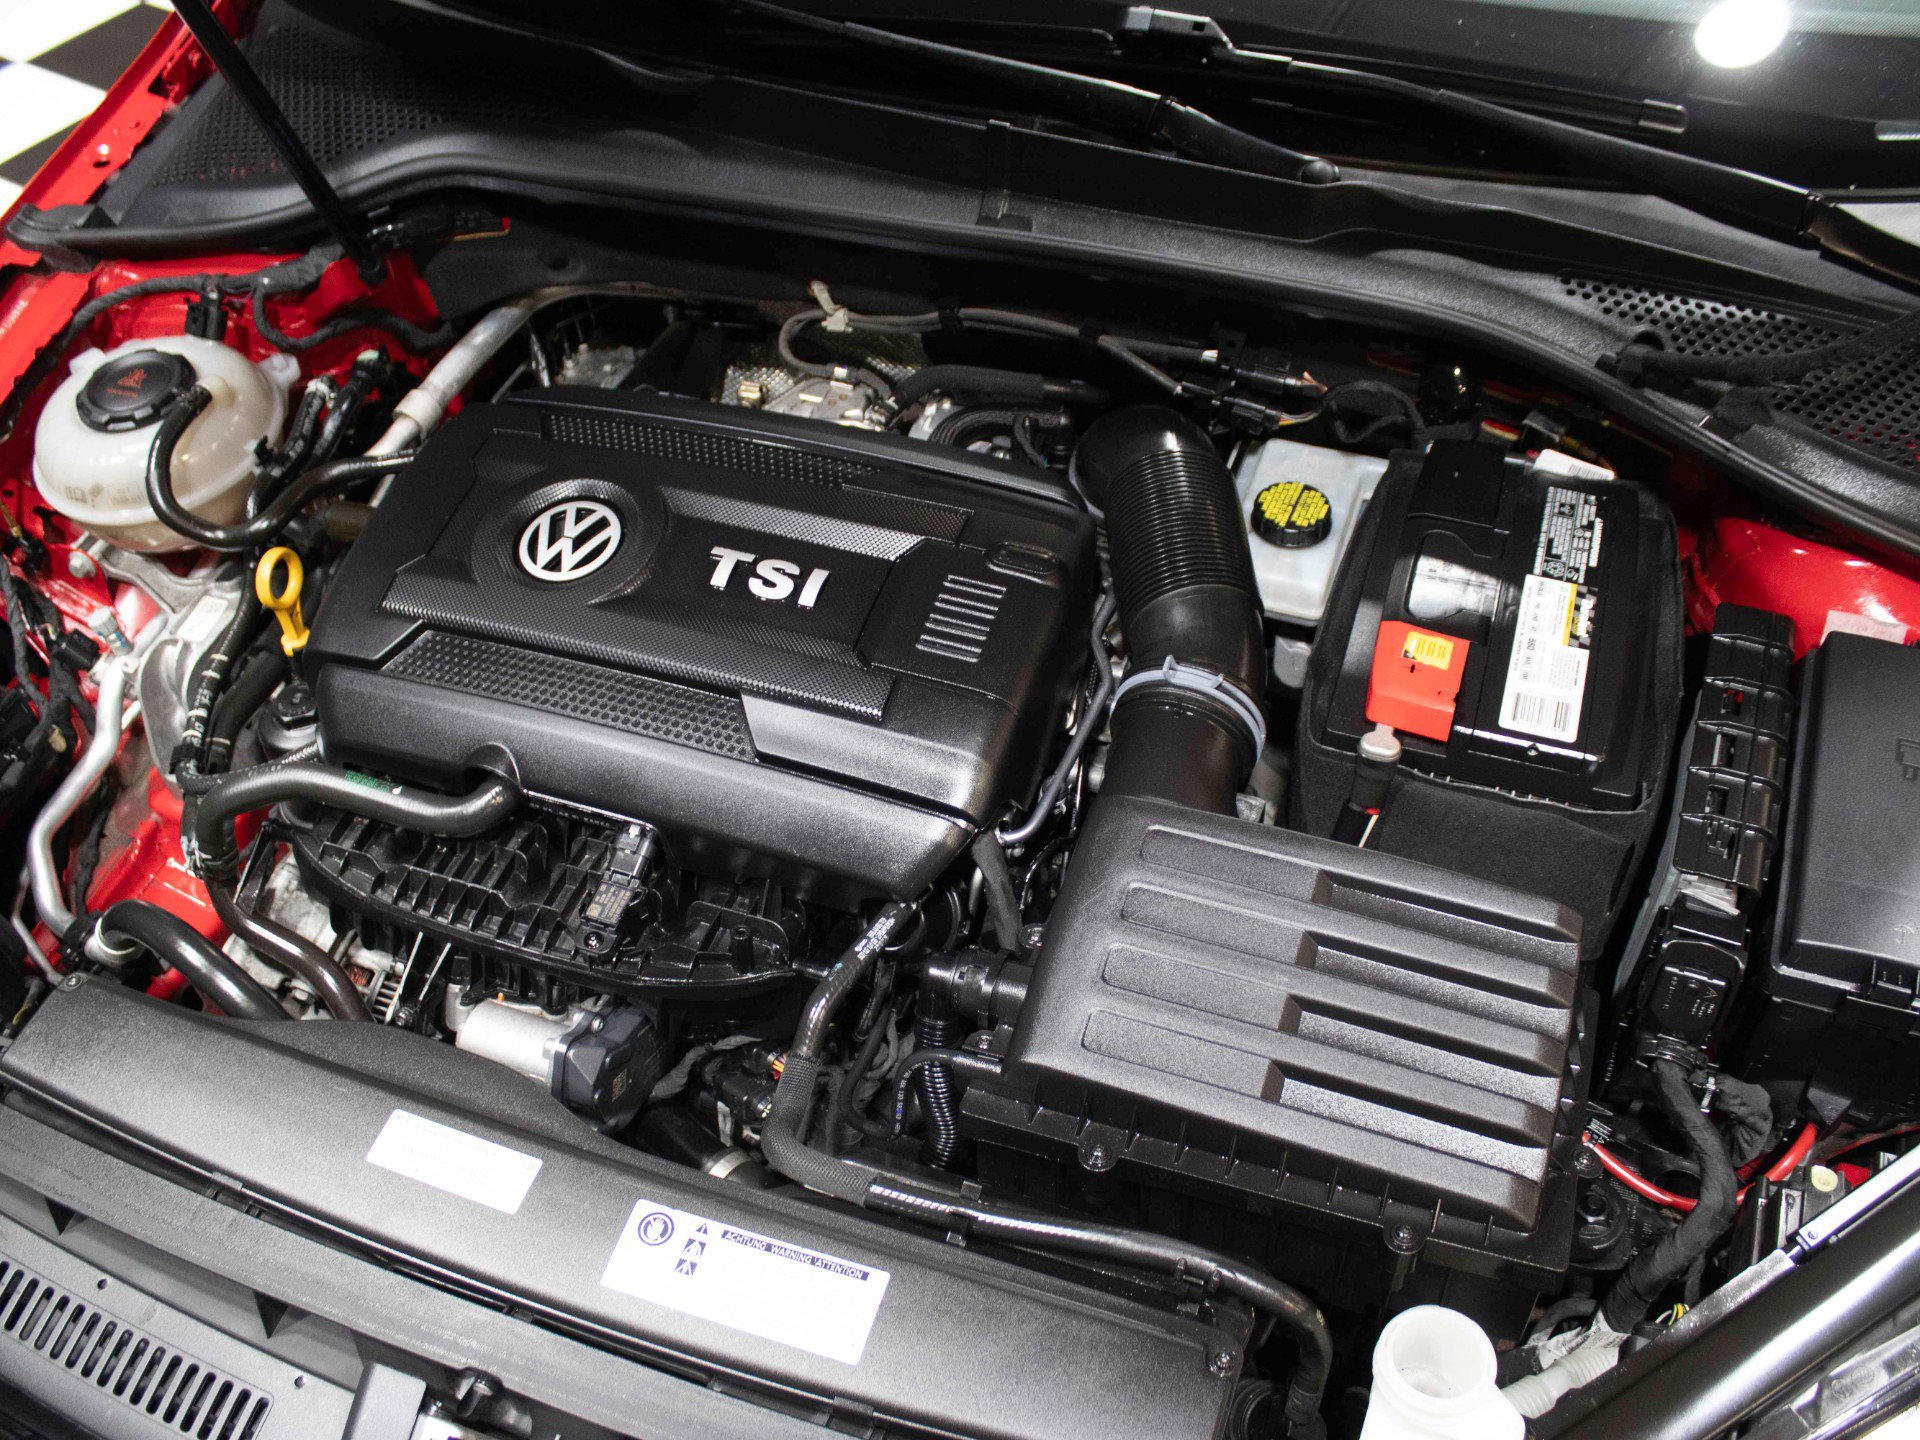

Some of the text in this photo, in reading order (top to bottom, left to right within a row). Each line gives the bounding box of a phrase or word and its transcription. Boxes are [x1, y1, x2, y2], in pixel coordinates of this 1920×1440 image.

[710, 545, 830, 608] TSI
[724, 1231, 863, 1280] ACHTUNG WARNING ATTENTION
